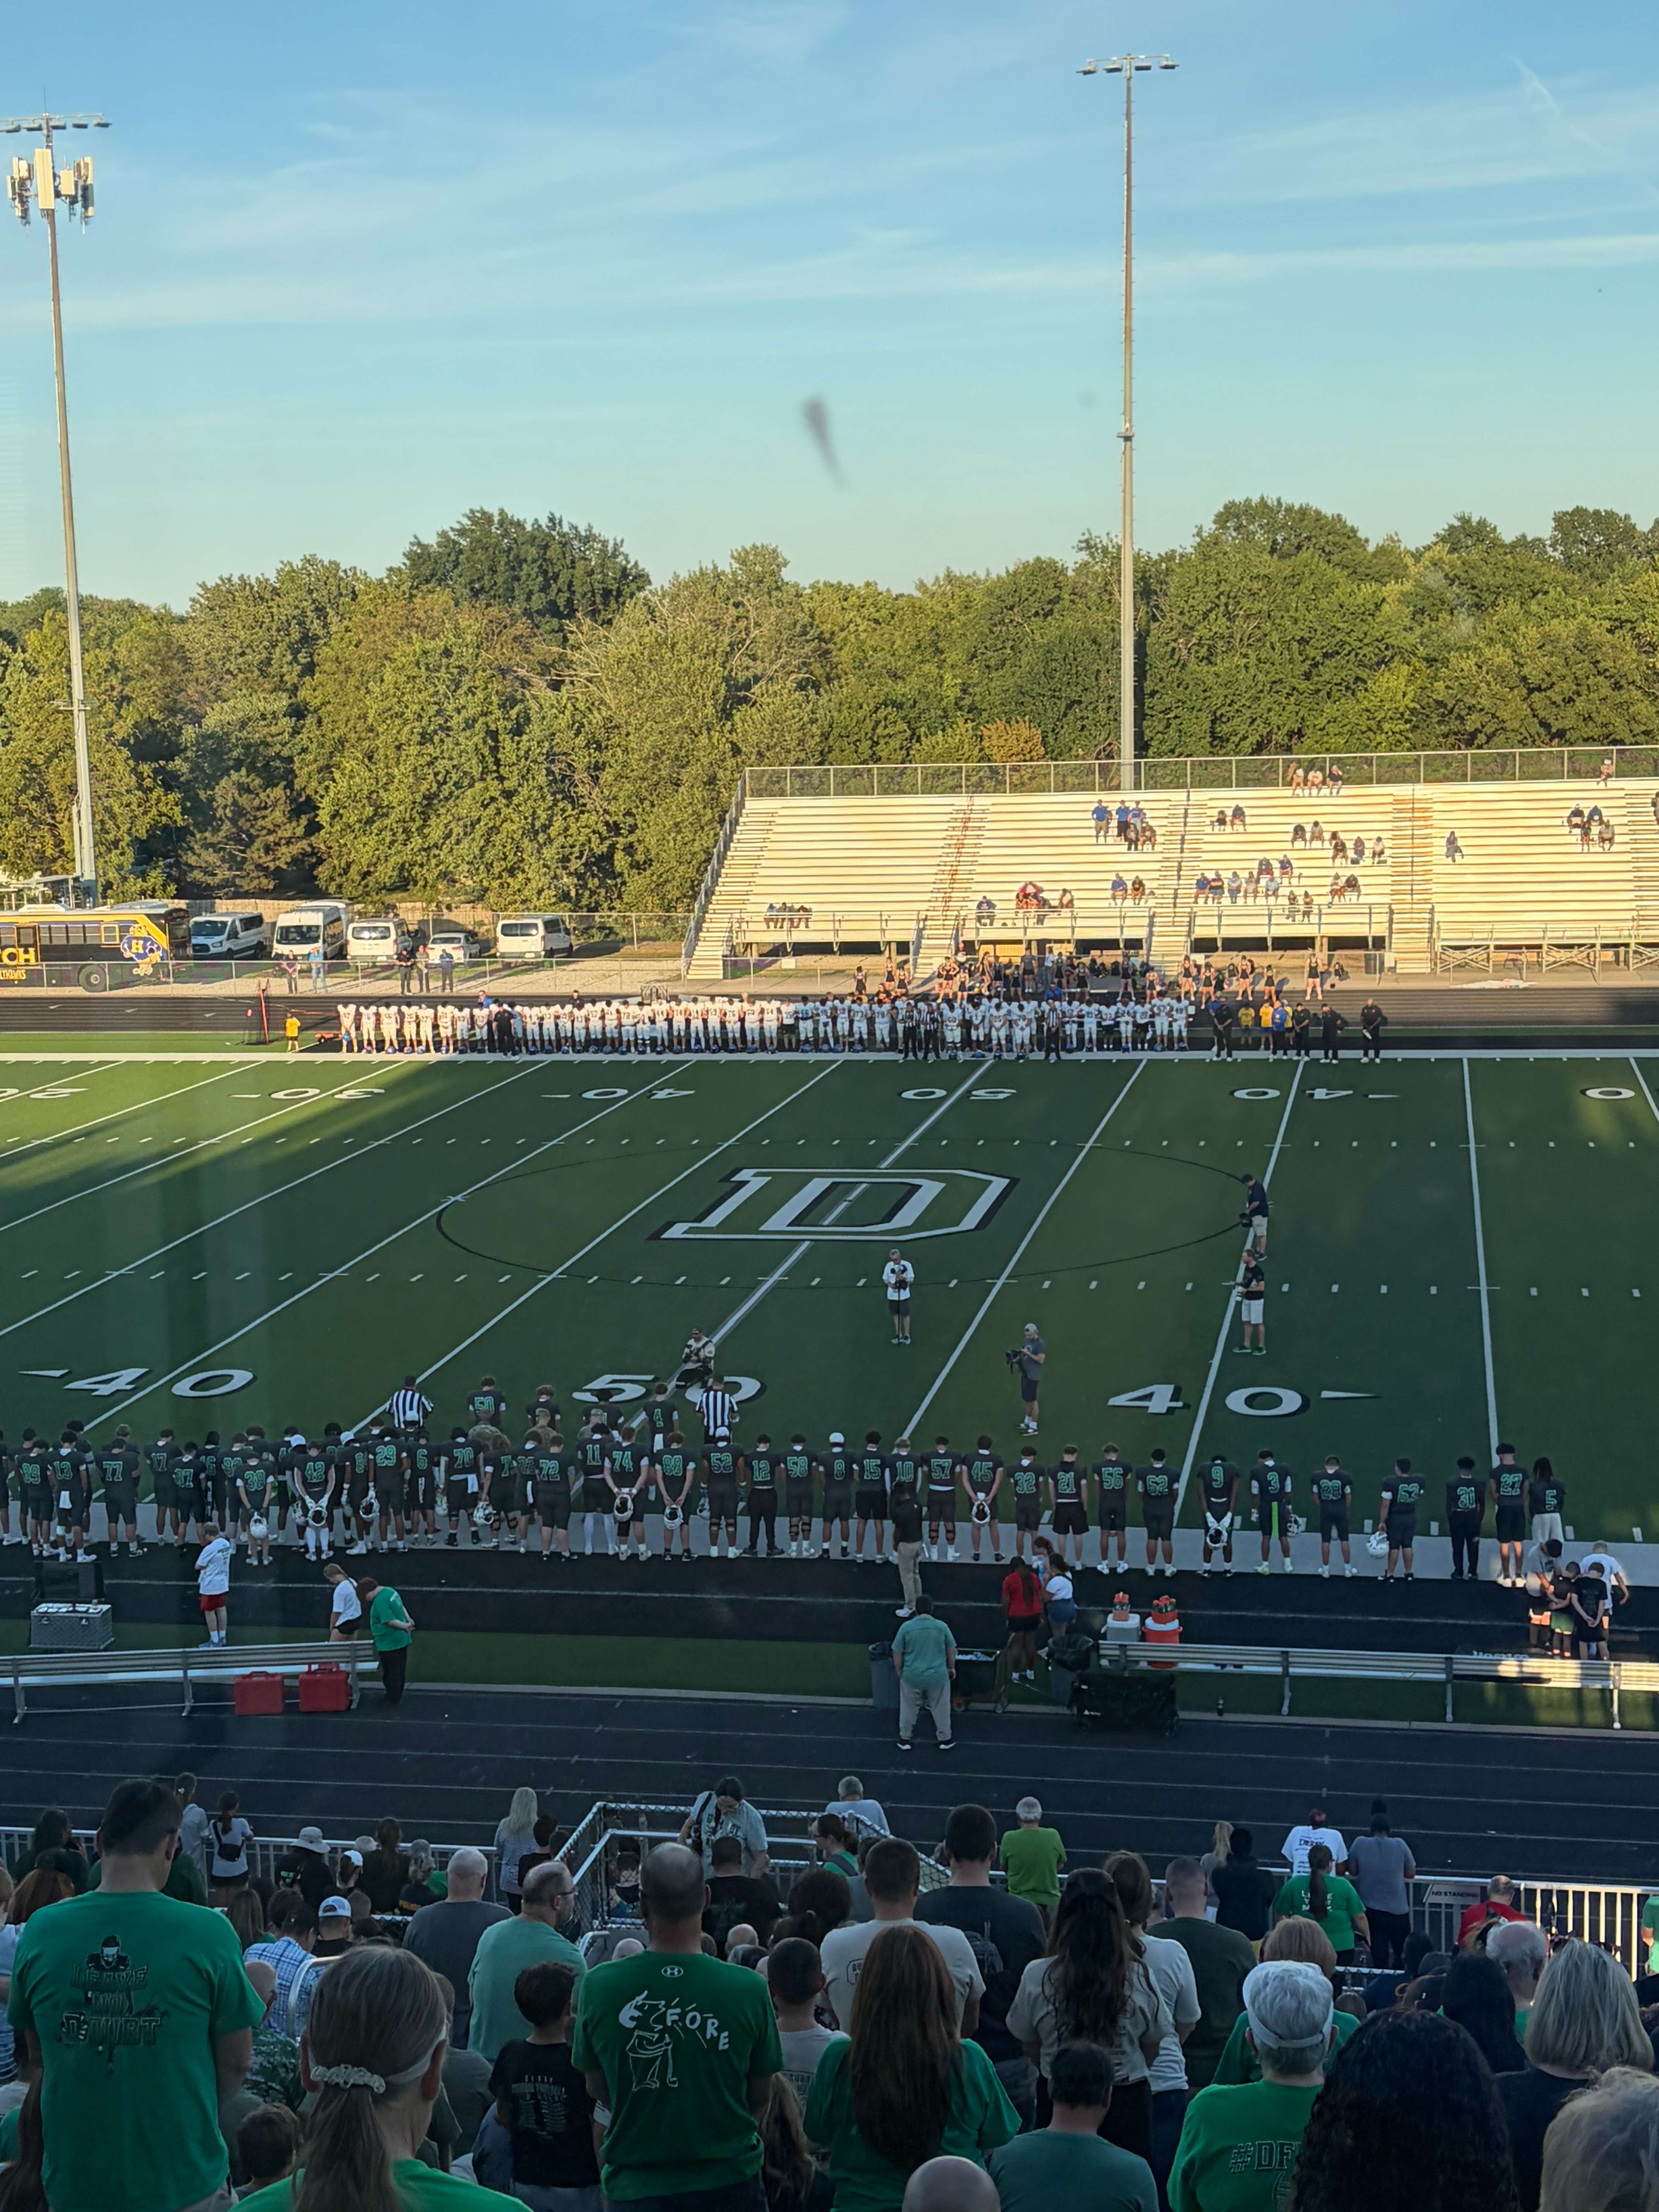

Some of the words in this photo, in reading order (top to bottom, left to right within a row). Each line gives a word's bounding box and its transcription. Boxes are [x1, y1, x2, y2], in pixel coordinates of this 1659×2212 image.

[131, 940, 143, 953] H
[151, 1453, 167, 1471] 17
[376, 1445, 396, 1467] 29
[417, 1449, 427, 1470] 6
[453, 1448, 474, 1468] 70
[586, 1444, 602, 1465] 11
[613, 1451, 633, 1472] 74
[711, 1453, 733, 1472] 52
[53, 1462, 73, 1479] 13
[103, 1461, 122, 1481] 77
[539, 1460, 560, 1481] 72
[752, 1460, 770, 1480] 12
[787, 1456, 808, 1477] 58
[835, 1459, 845, 1480] 8
[864, 1459, 881, 1479] 15
[896, 1461, 914, 1482] 10
[931, 1459, 952, 1479] 57
[971, 1462, 993, 1481] 45
[1211, 1466, 1224, 1488] 9
[175, 1468, 193, 1488] 97
[1015, 1472, 1036, 1493] 32
[1058, 1472, 1076, 1493] 21
[1102, 1468, 1123, 1489] 56
[1267, 1472, 1280, 1493] 3
[1500, 1473, 1523, 1495] 27
[1457, 1487, 1476, 1508] 31
[1545, 1490, 1557, 1511] 5
[666, 2007, 730, 2051] FORE
